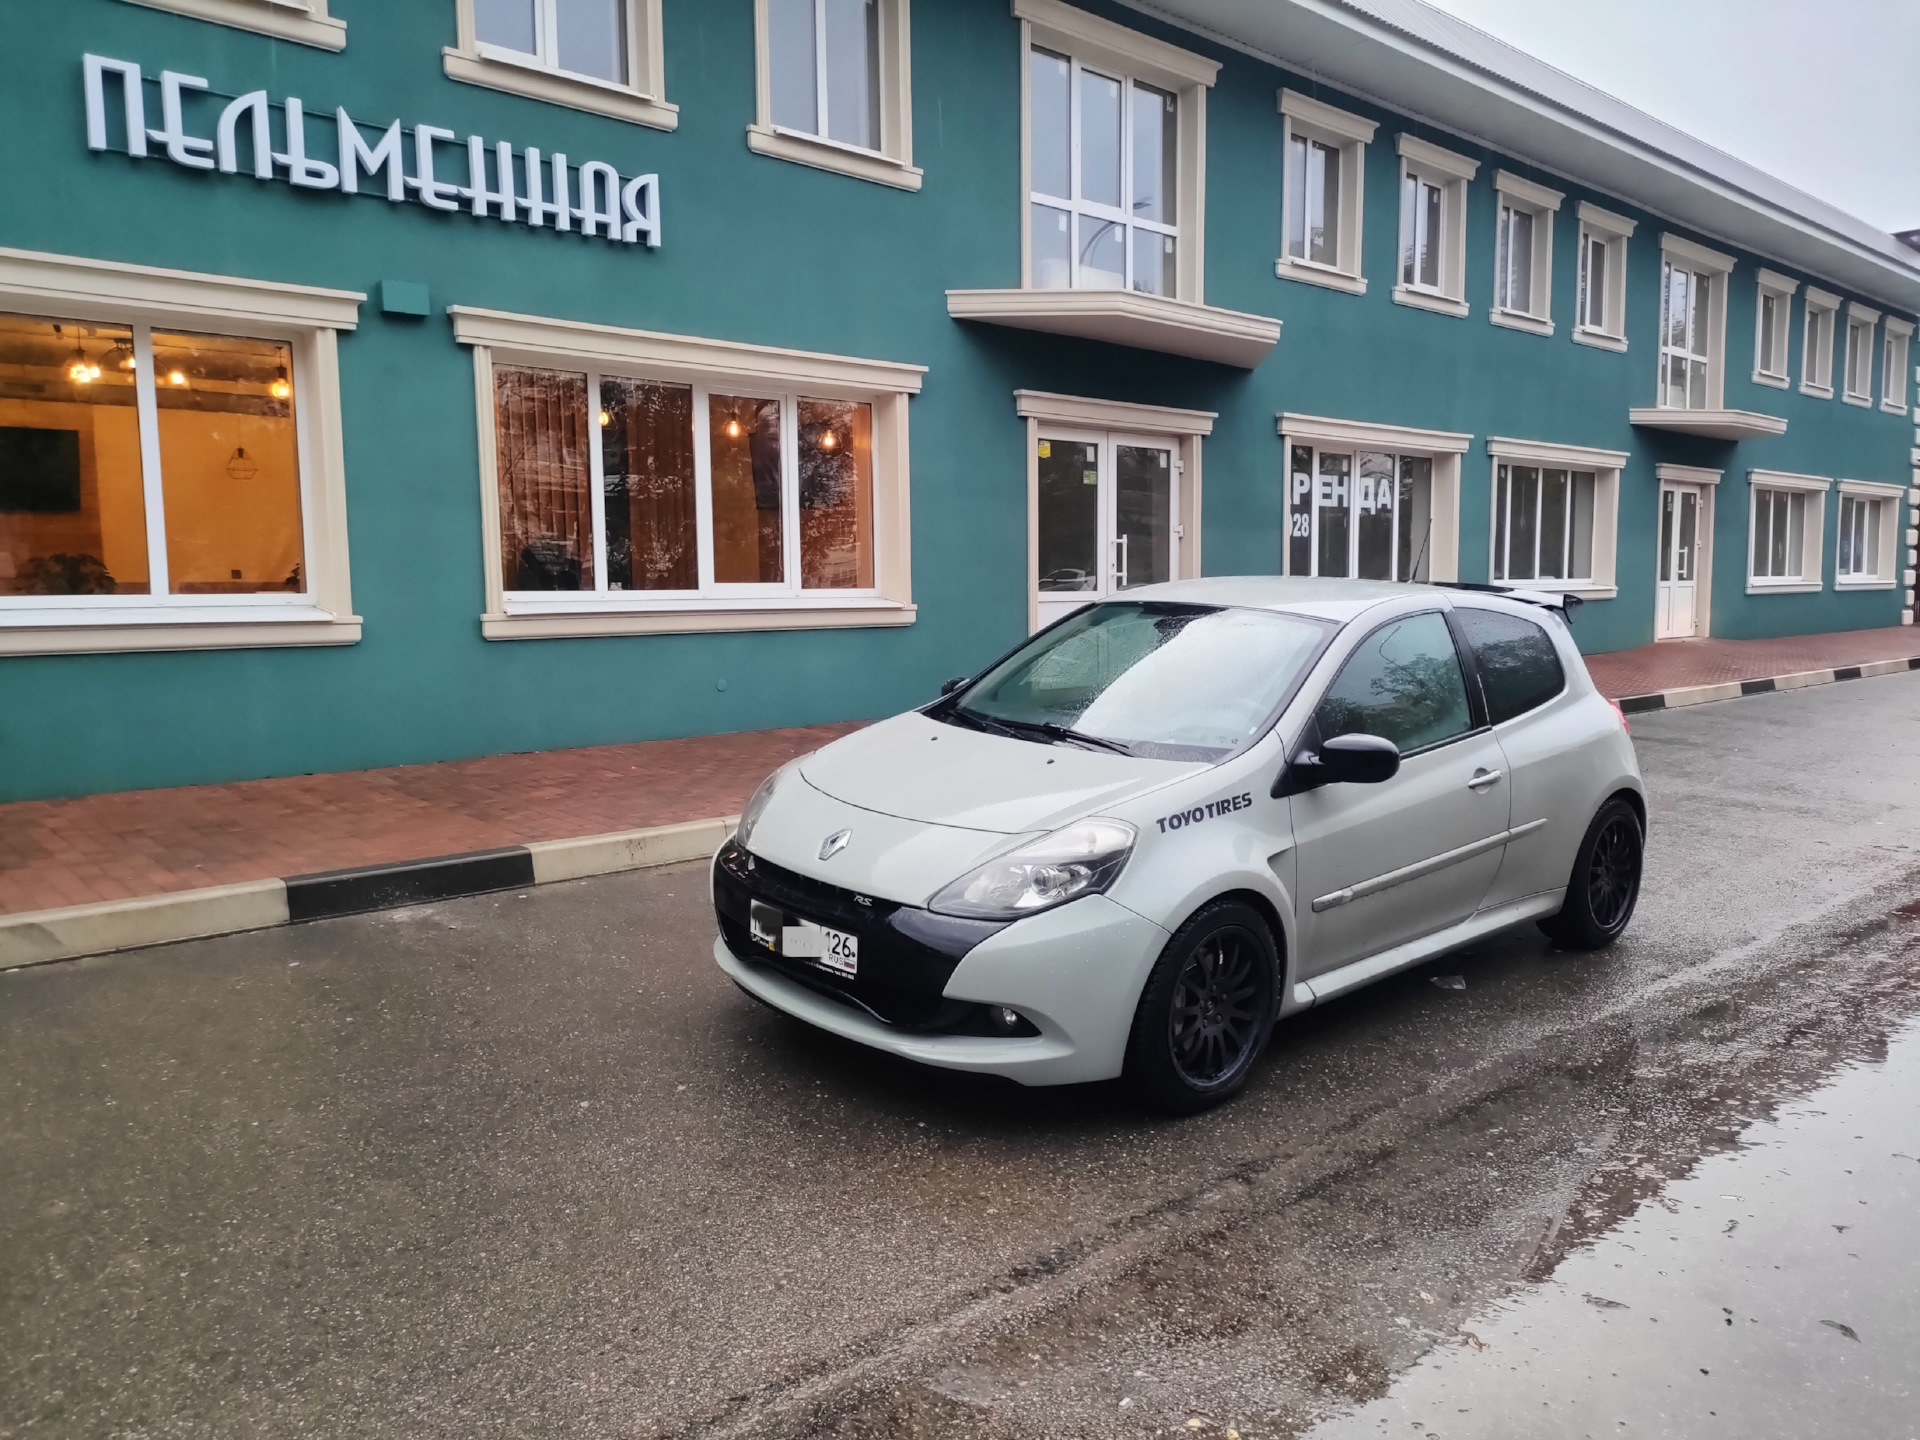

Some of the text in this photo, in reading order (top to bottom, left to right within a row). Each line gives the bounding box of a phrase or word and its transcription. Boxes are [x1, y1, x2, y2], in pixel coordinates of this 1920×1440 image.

[83, 52, 662, 248] ПЕЛЬМЕННАЯ
[1290, 472, 1392, 515] РЕНДА
[1290, 513, 1310, 537] 28
[1156, 792, 1253, 834] TOYO TIRES
[825, 931, 851, 957] 126
[828, 953, 844, 966] RUS
